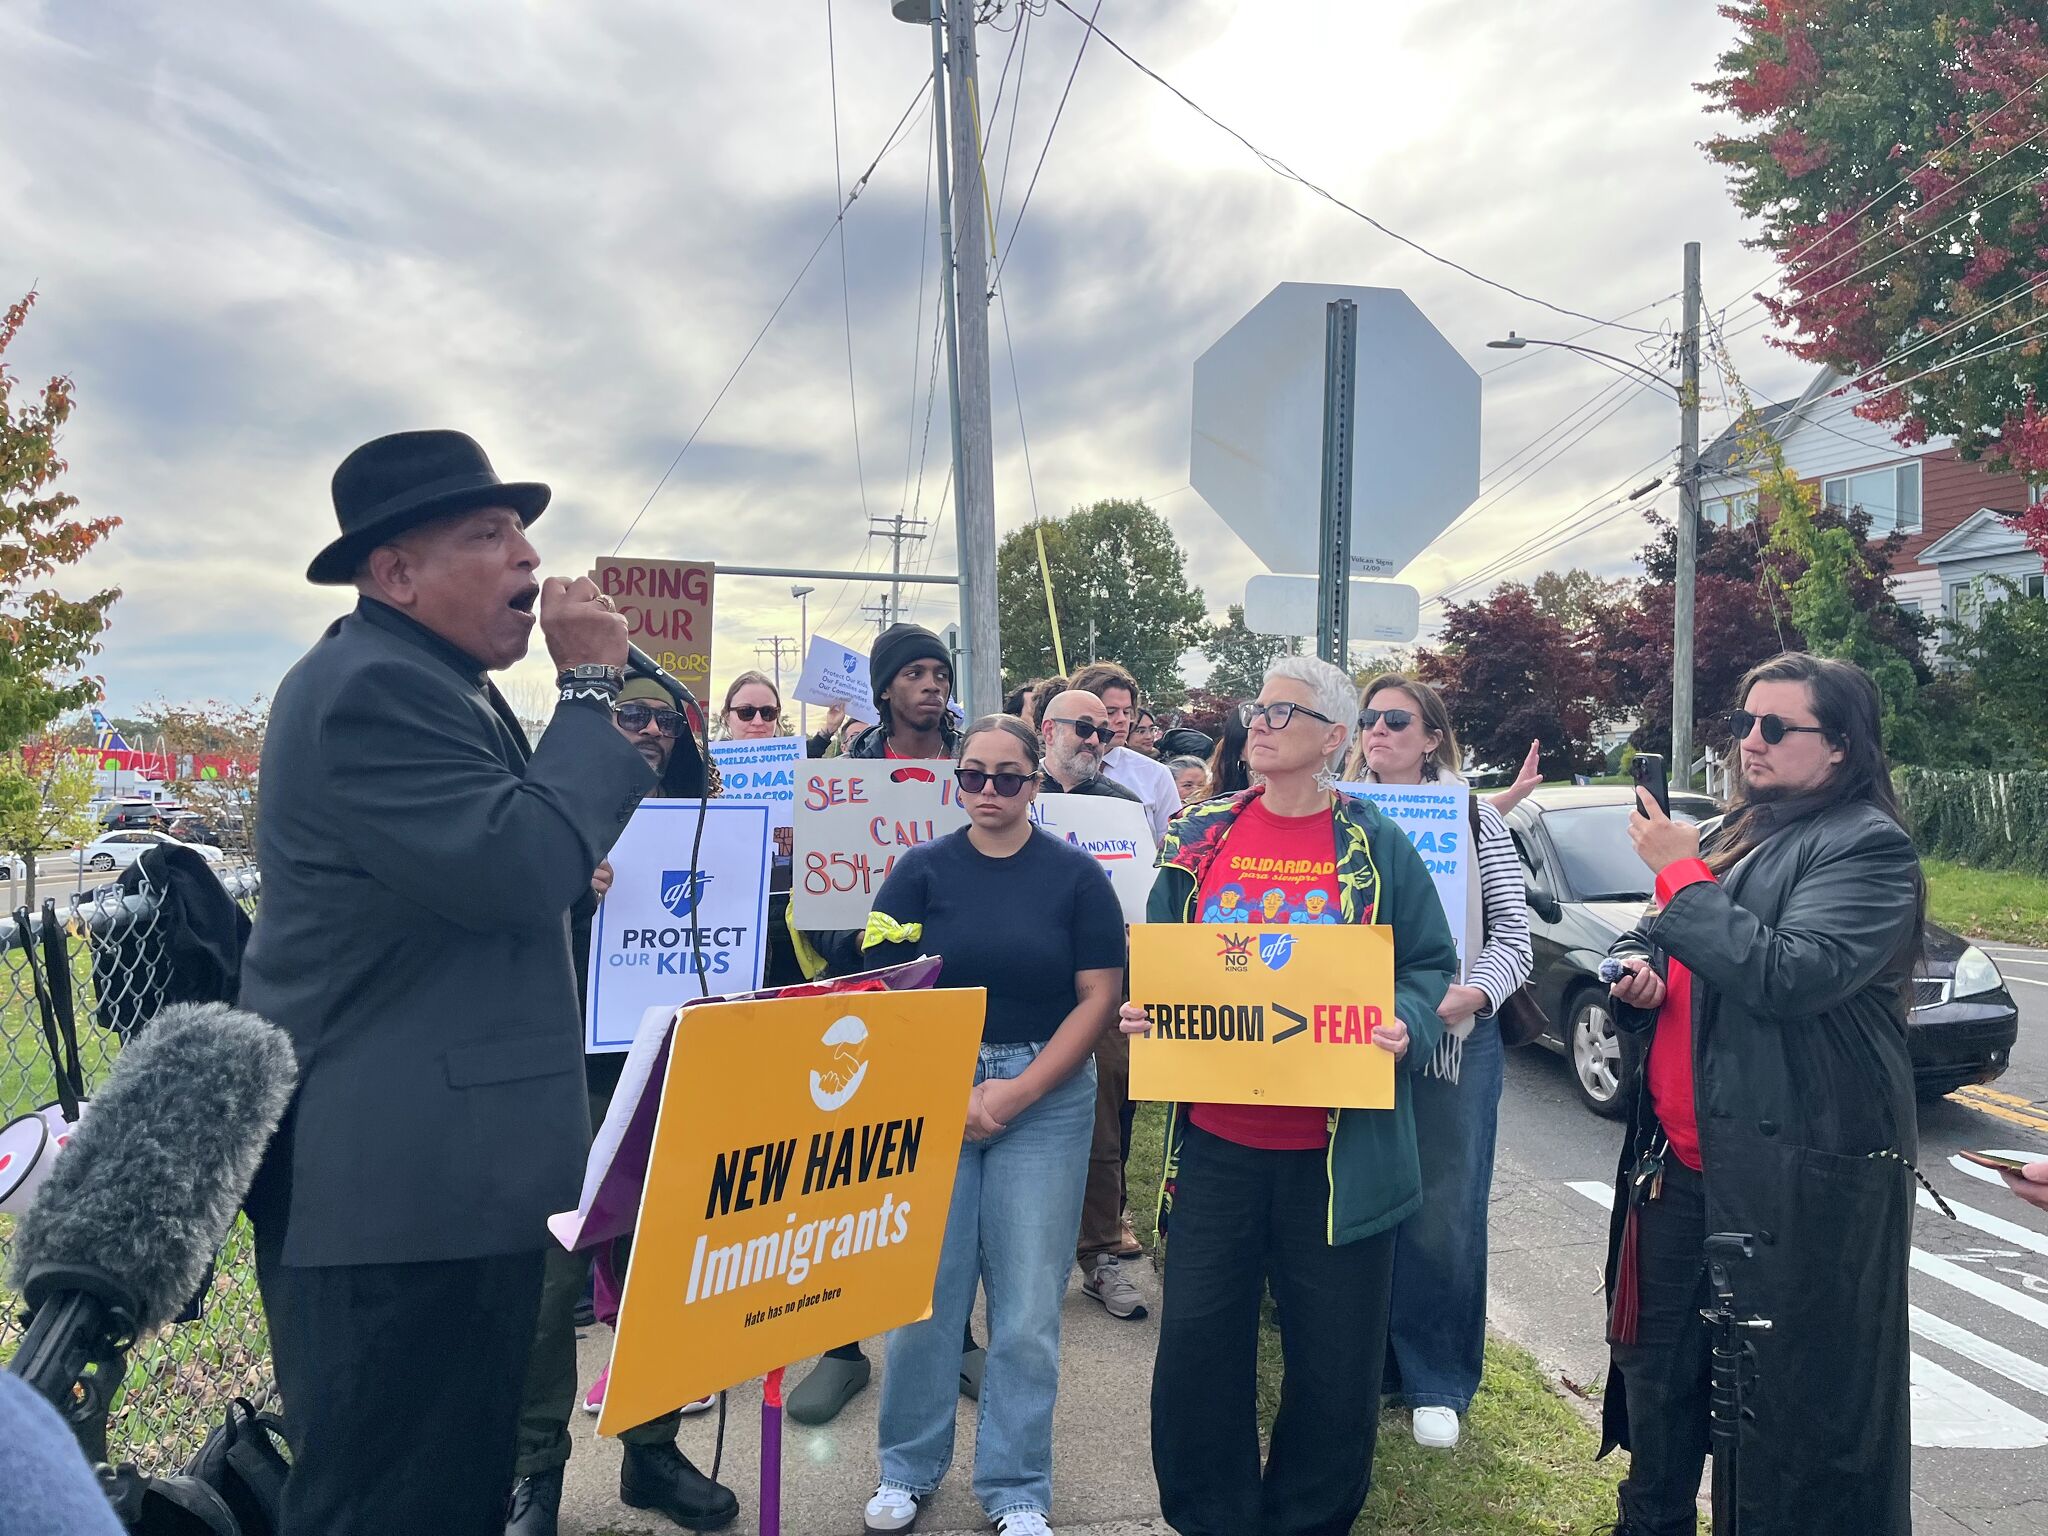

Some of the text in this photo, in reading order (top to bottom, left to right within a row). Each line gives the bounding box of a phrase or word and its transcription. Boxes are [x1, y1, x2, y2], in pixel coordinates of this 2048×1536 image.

[1351, 556, 1393, 567] Vulcan Signs
[602, 565, 708, 607] BRING
[821, 674, 834, 684] Our
[824, 667, 845, 680] Protect
[845, 675, 856, 683] Our
[818, 682, 831, 691] Our
[749, 746, 756, 754] A
[756, 743, 798, 753] NUESTRAS
[715, 753, 800, 766] AMILIAS JUNTAS
[804, 775, 870, 812] SEE
[1399, 794, 1456, 805] NUESTRAS
[1400, 808, 1458, 820] JUNTAS
[1230, 855, 1336, 875] SOLIDARIDAD
[1238, 871, 1320, 885] para siempre
[622, 927, 747, 949] PROTECT
[609, 951, 730, 975] OUR KIDS
[1224, 954, 1249, 967] NO
[1143, 1003, 1264, 1042] FREEDOM
[704, 1116, 925, 1220] NEW HAVEN
[684, 1192, 911, 1305] Immigrants
[744, 1286, 842, 1328] Hate has no place here
